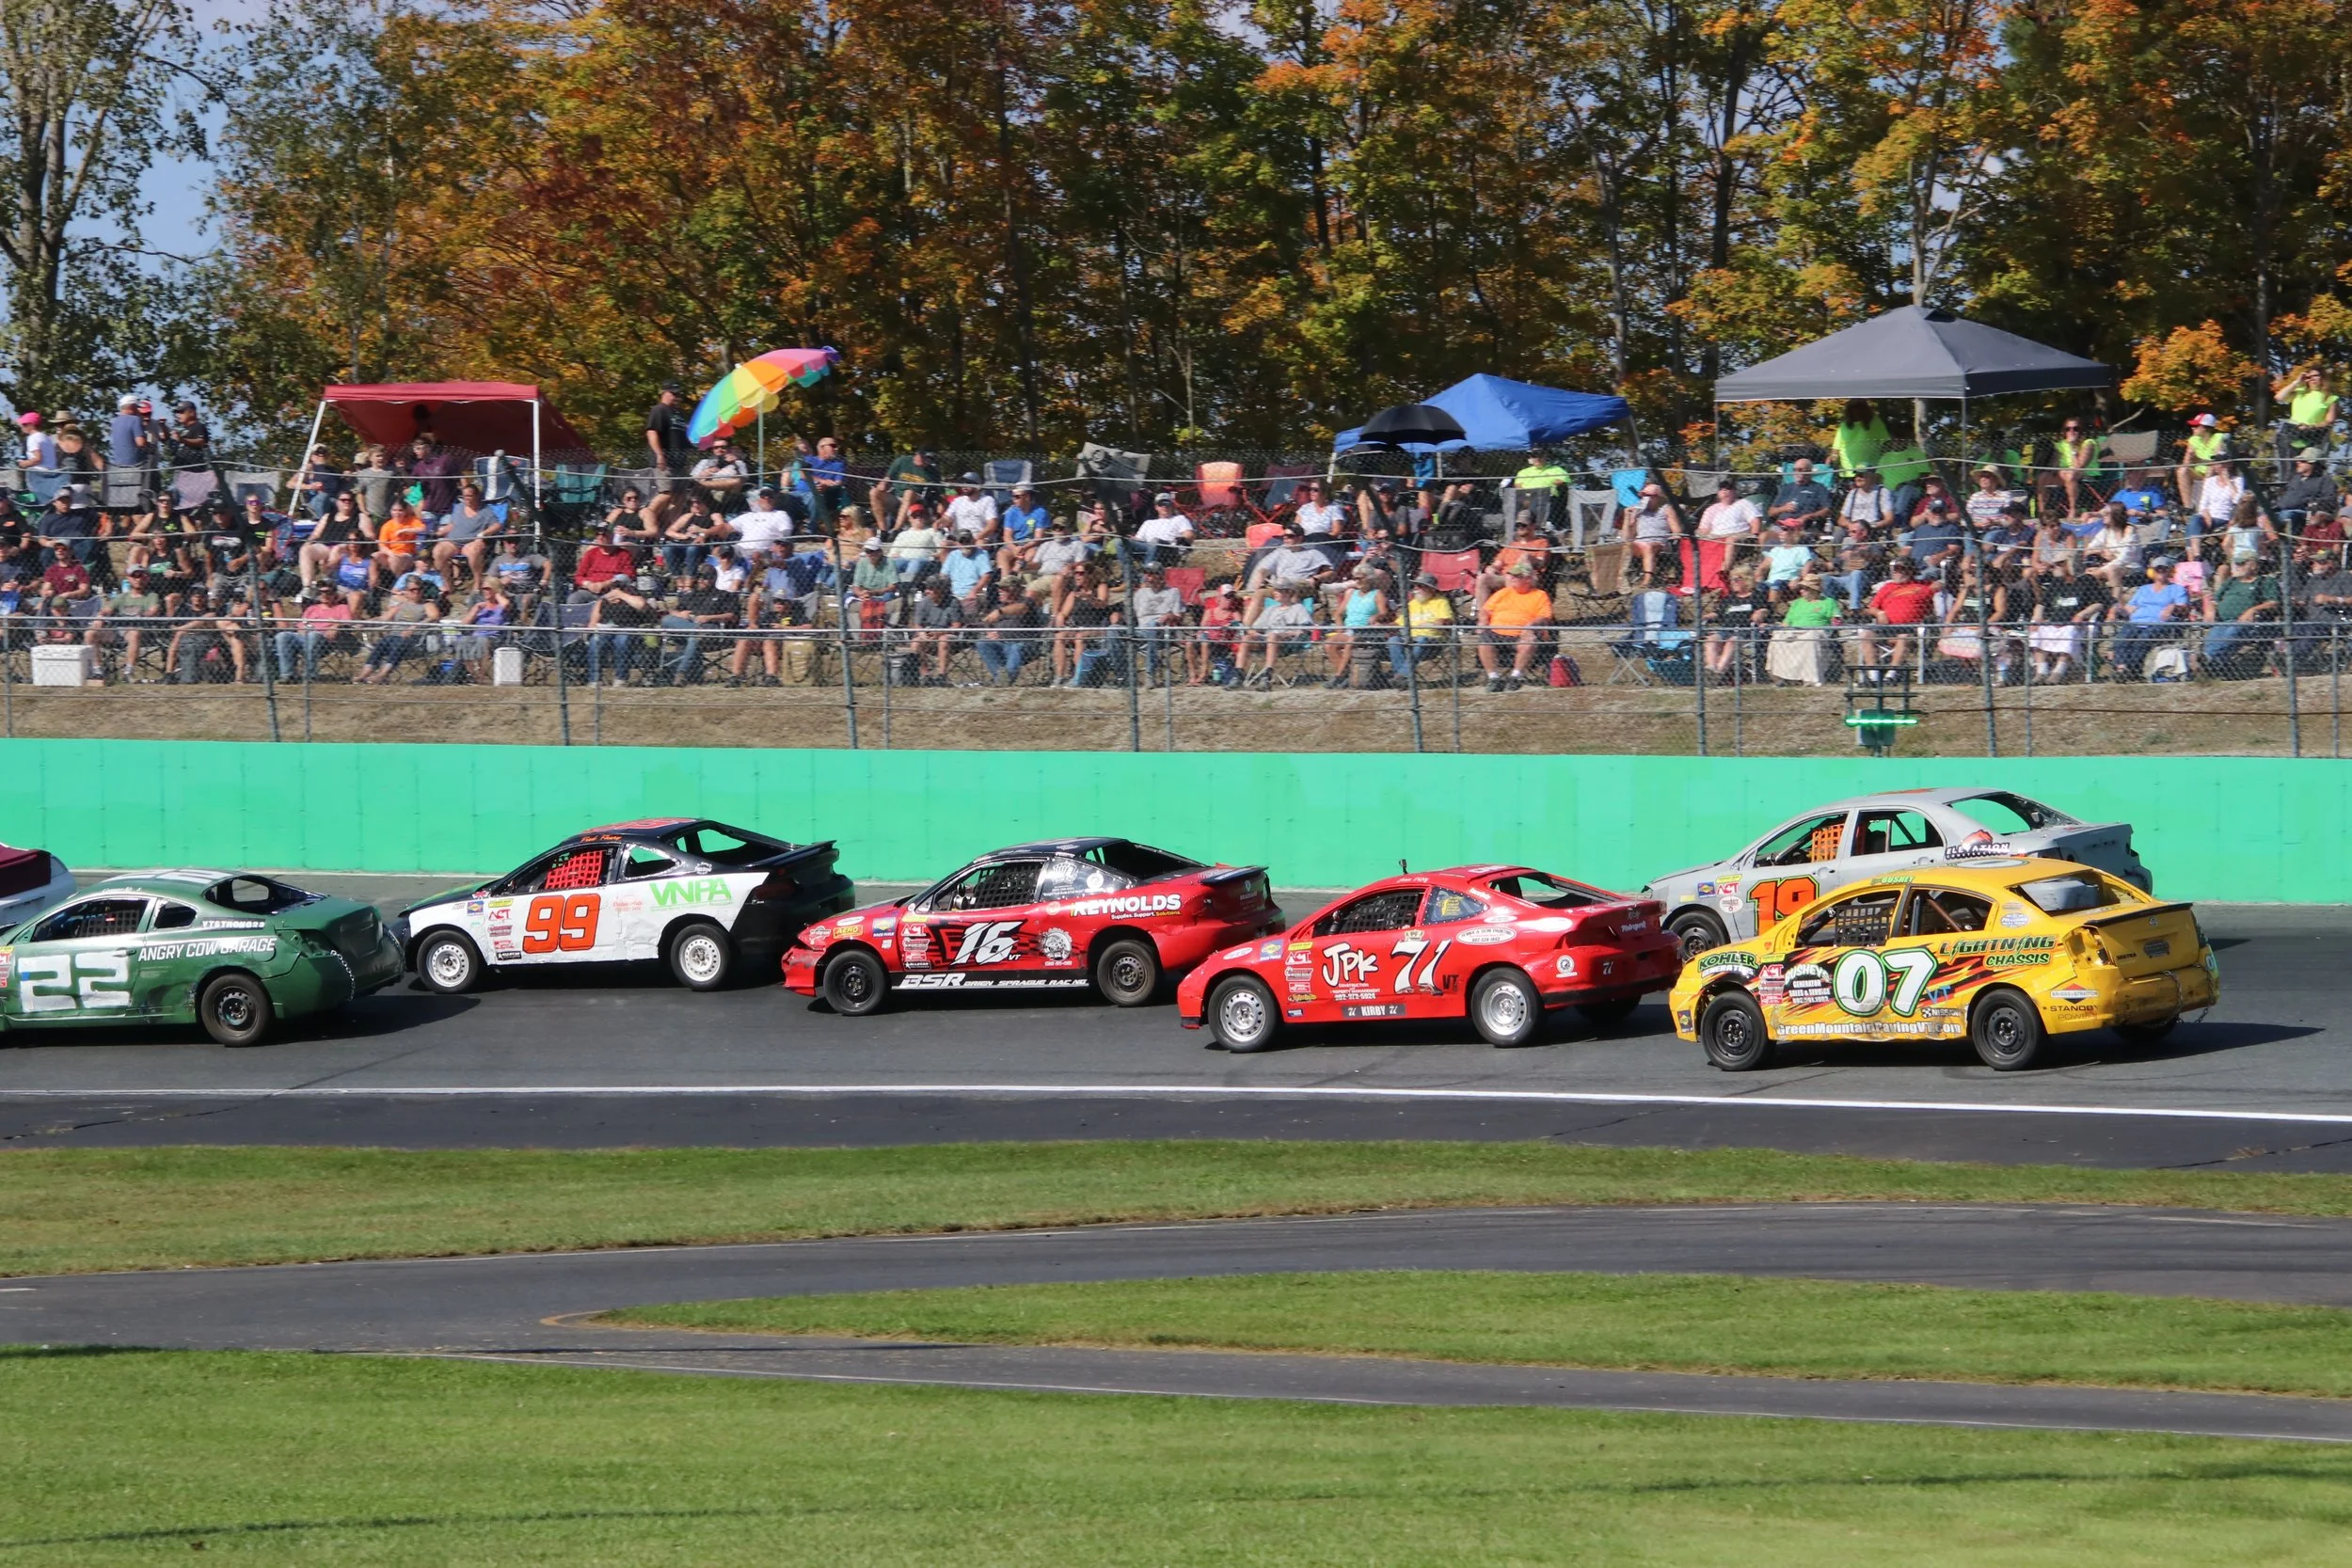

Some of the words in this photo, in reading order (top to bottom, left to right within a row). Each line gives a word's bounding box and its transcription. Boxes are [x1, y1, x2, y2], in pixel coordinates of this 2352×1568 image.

[649, 878, 732, 906] VNPA
[1073, 894, 1182, 917] REYNOLDS
[522, 893, 601, 954] 99
[137, 943, 185, 962] ANGRY
[185, 940, 222, 958] COW
[219, 938, 278, 956] GARAGE
[952, 921, 1024, 965] 16
[1939, 935, 2057, 959] LIGHTNING
[1391, 939, 1453, 995] 71
[1442, 974, 1460, 990] VT
[1698, 951, 1759, 973] KOHLER
[1986, 953, 2050, 967] CHASSIS
[18, 950, 131, 1014] 22
[899, 973, 966, 988] BSR
[1834, 947, 1938, 1018] 07
[1926, 985, 1951, 1005] VT
[1360, 1006, 1386, 1017] KIRBY
